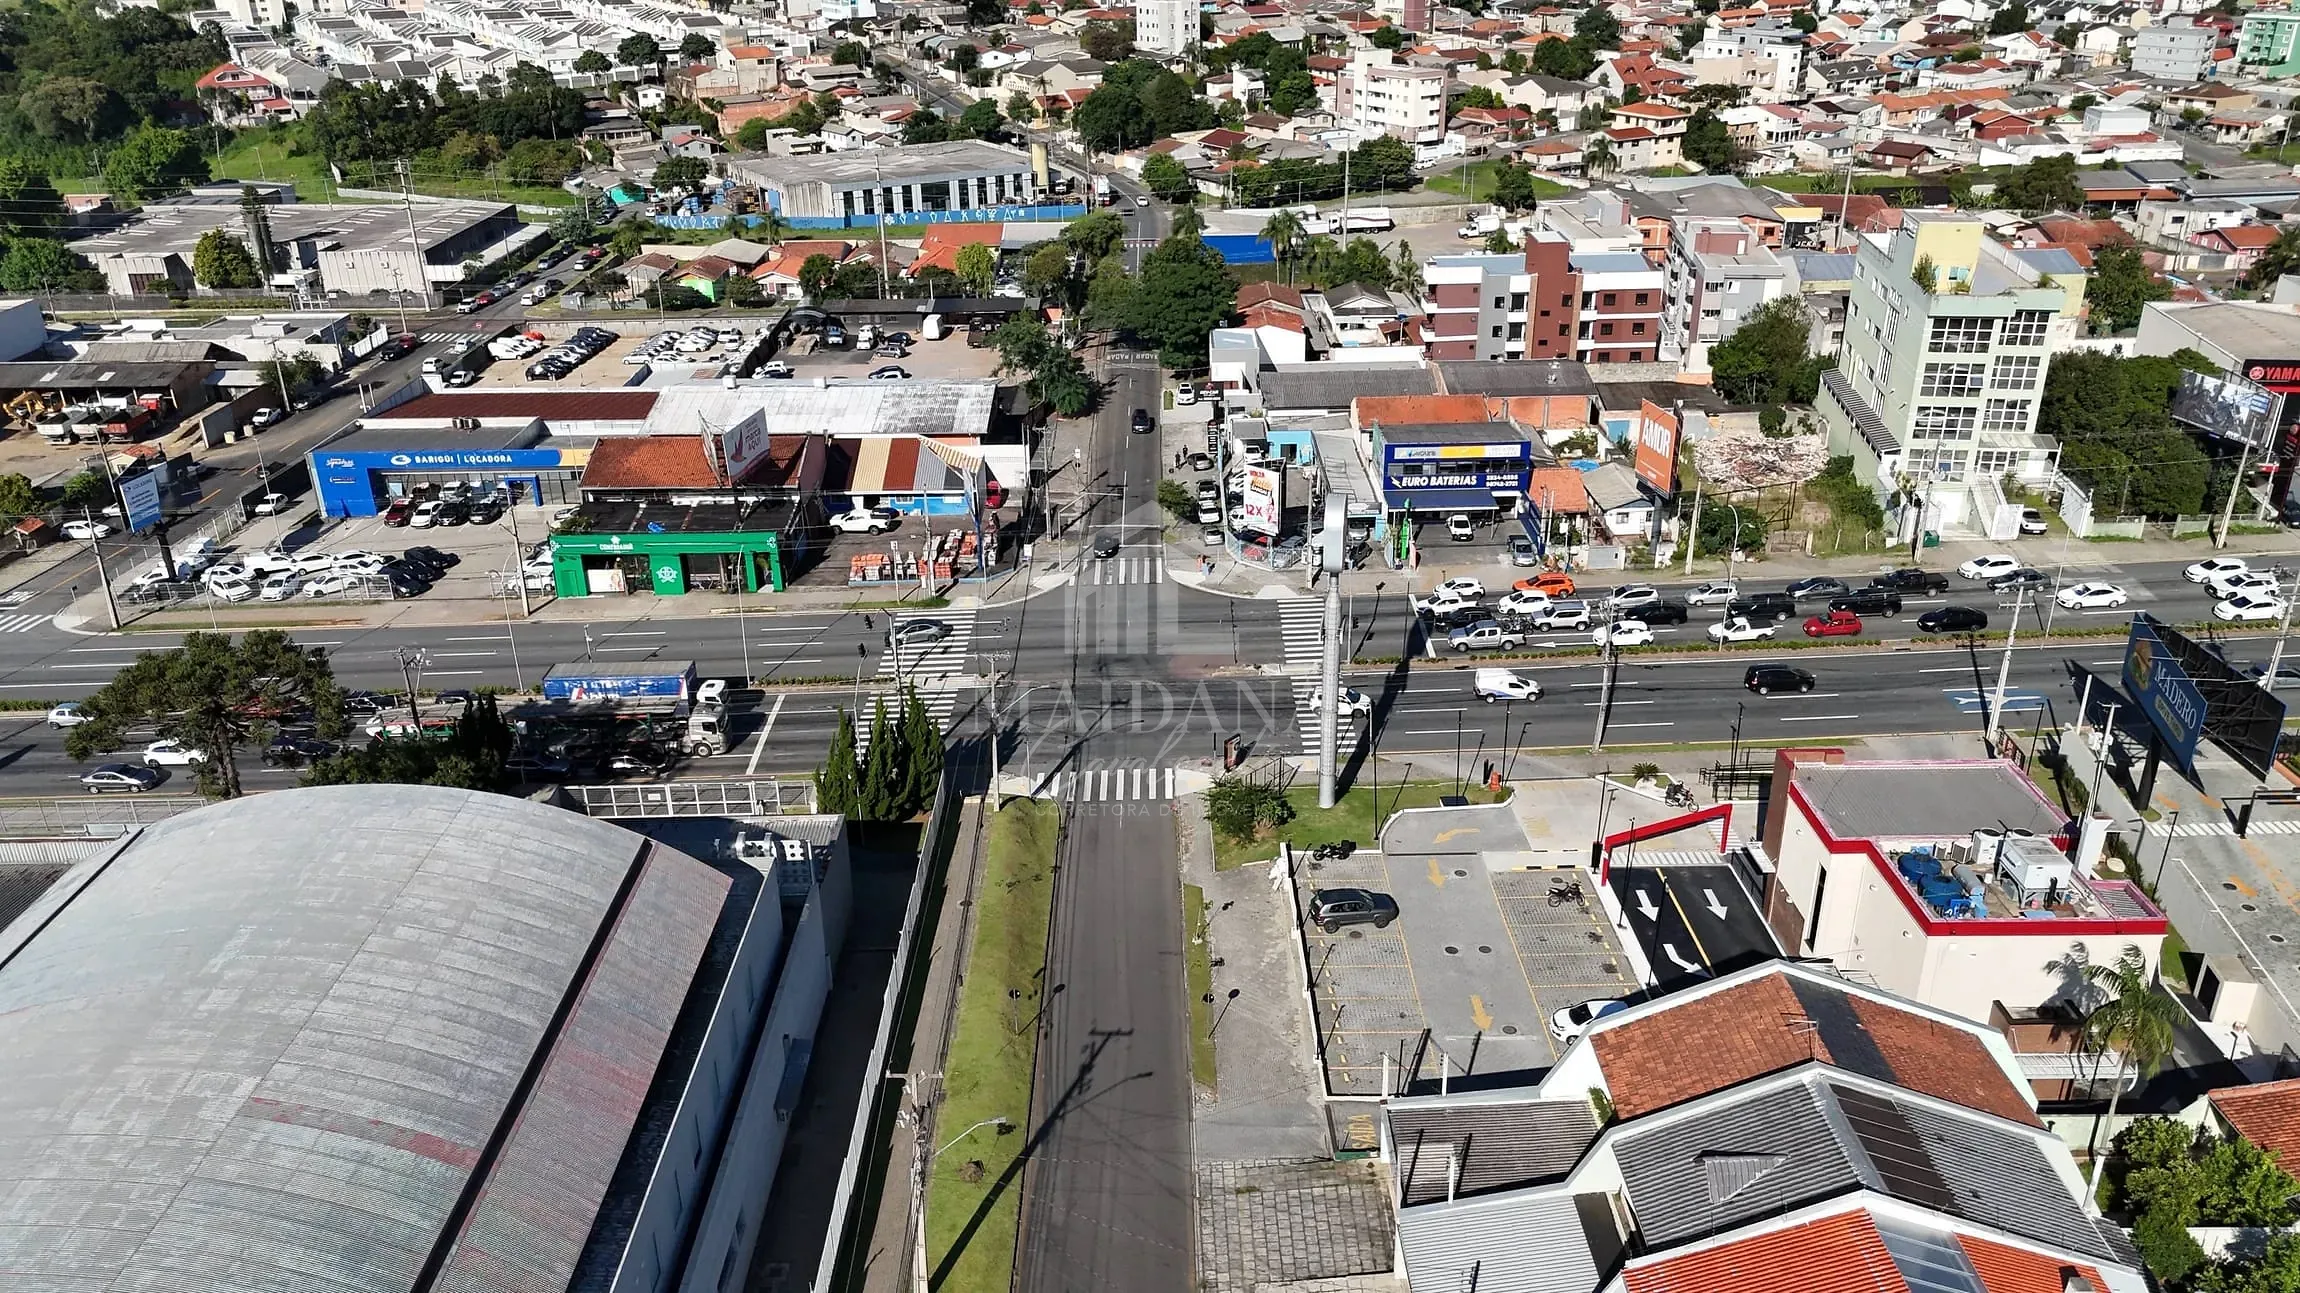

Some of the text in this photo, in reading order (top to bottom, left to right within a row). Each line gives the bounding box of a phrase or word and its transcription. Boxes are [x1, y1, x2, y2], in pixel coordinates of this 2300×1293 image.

[1641, 417, 1671, 458] AMOR
[463, 454, 513, 465] LOCADORA
[1401, 475, 1478, 487] EURO BATERIAS
[2154, 660, 2197, 730] MADERO
